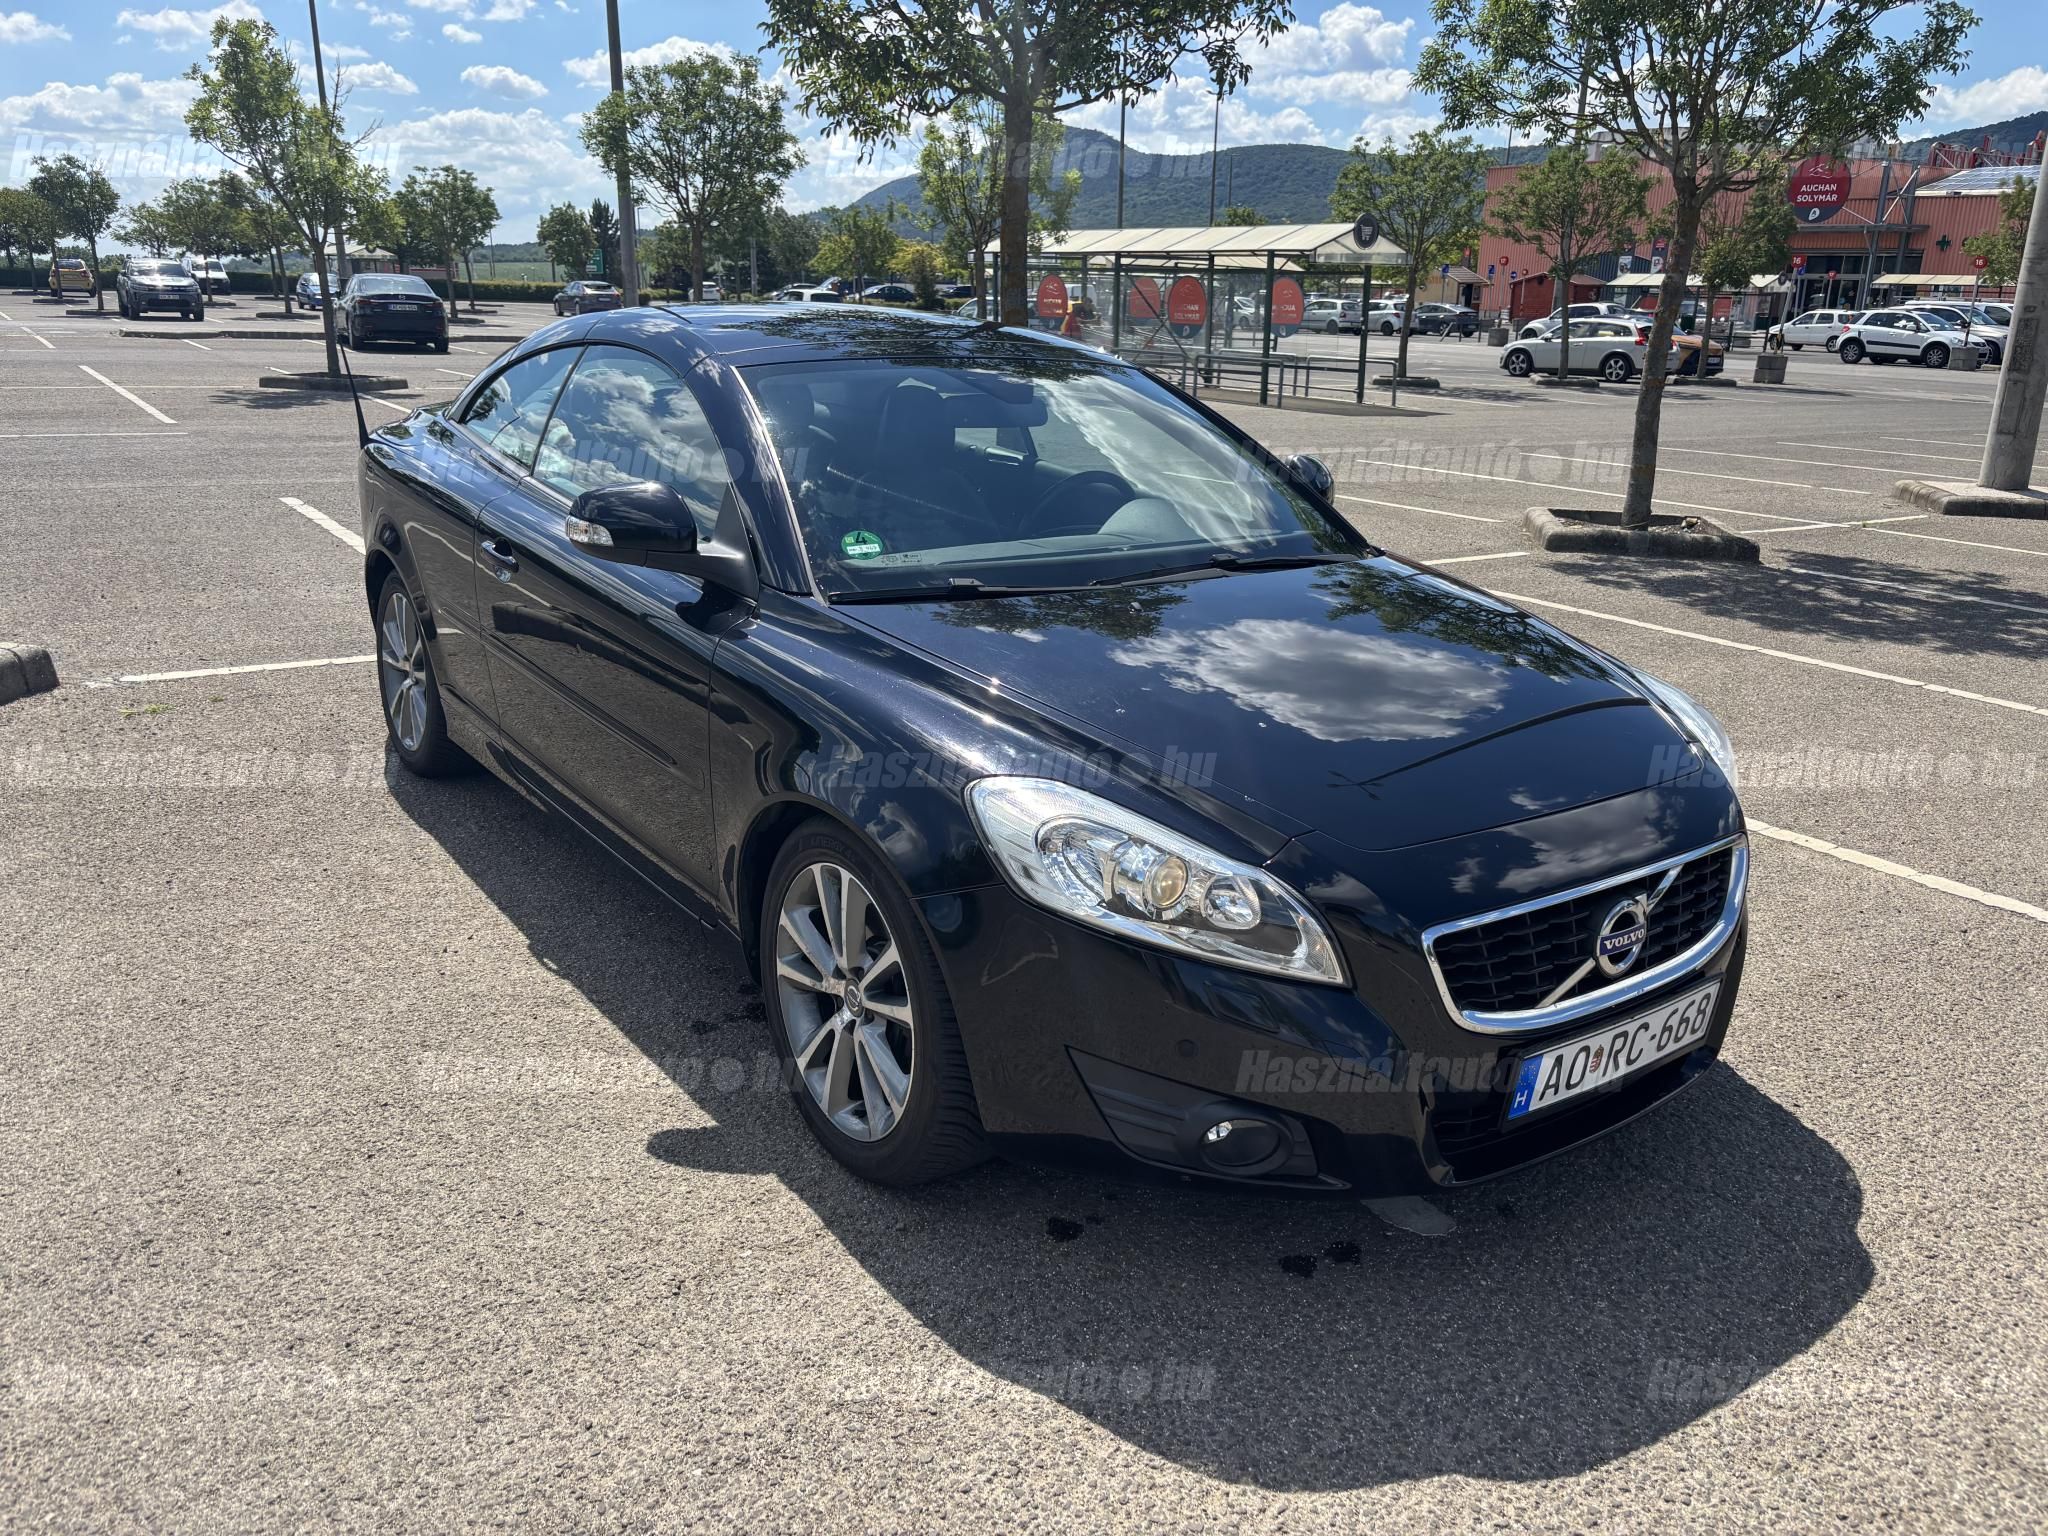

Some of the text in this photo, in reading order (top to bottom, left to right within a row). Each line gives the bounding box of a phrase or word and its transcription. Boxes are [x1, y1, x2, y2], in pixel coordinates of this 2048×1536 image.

[1800, 184, 1837, 192] AUCHAN
[1797, 193, 1838, 202] SOLYMÁR
[1793, 256, 1801, 264] 16
[856, 532, 868, 545] 4
[1604, 928, 1645, 950] VOLVO
[1513, 1089, 1528, 1109] H
